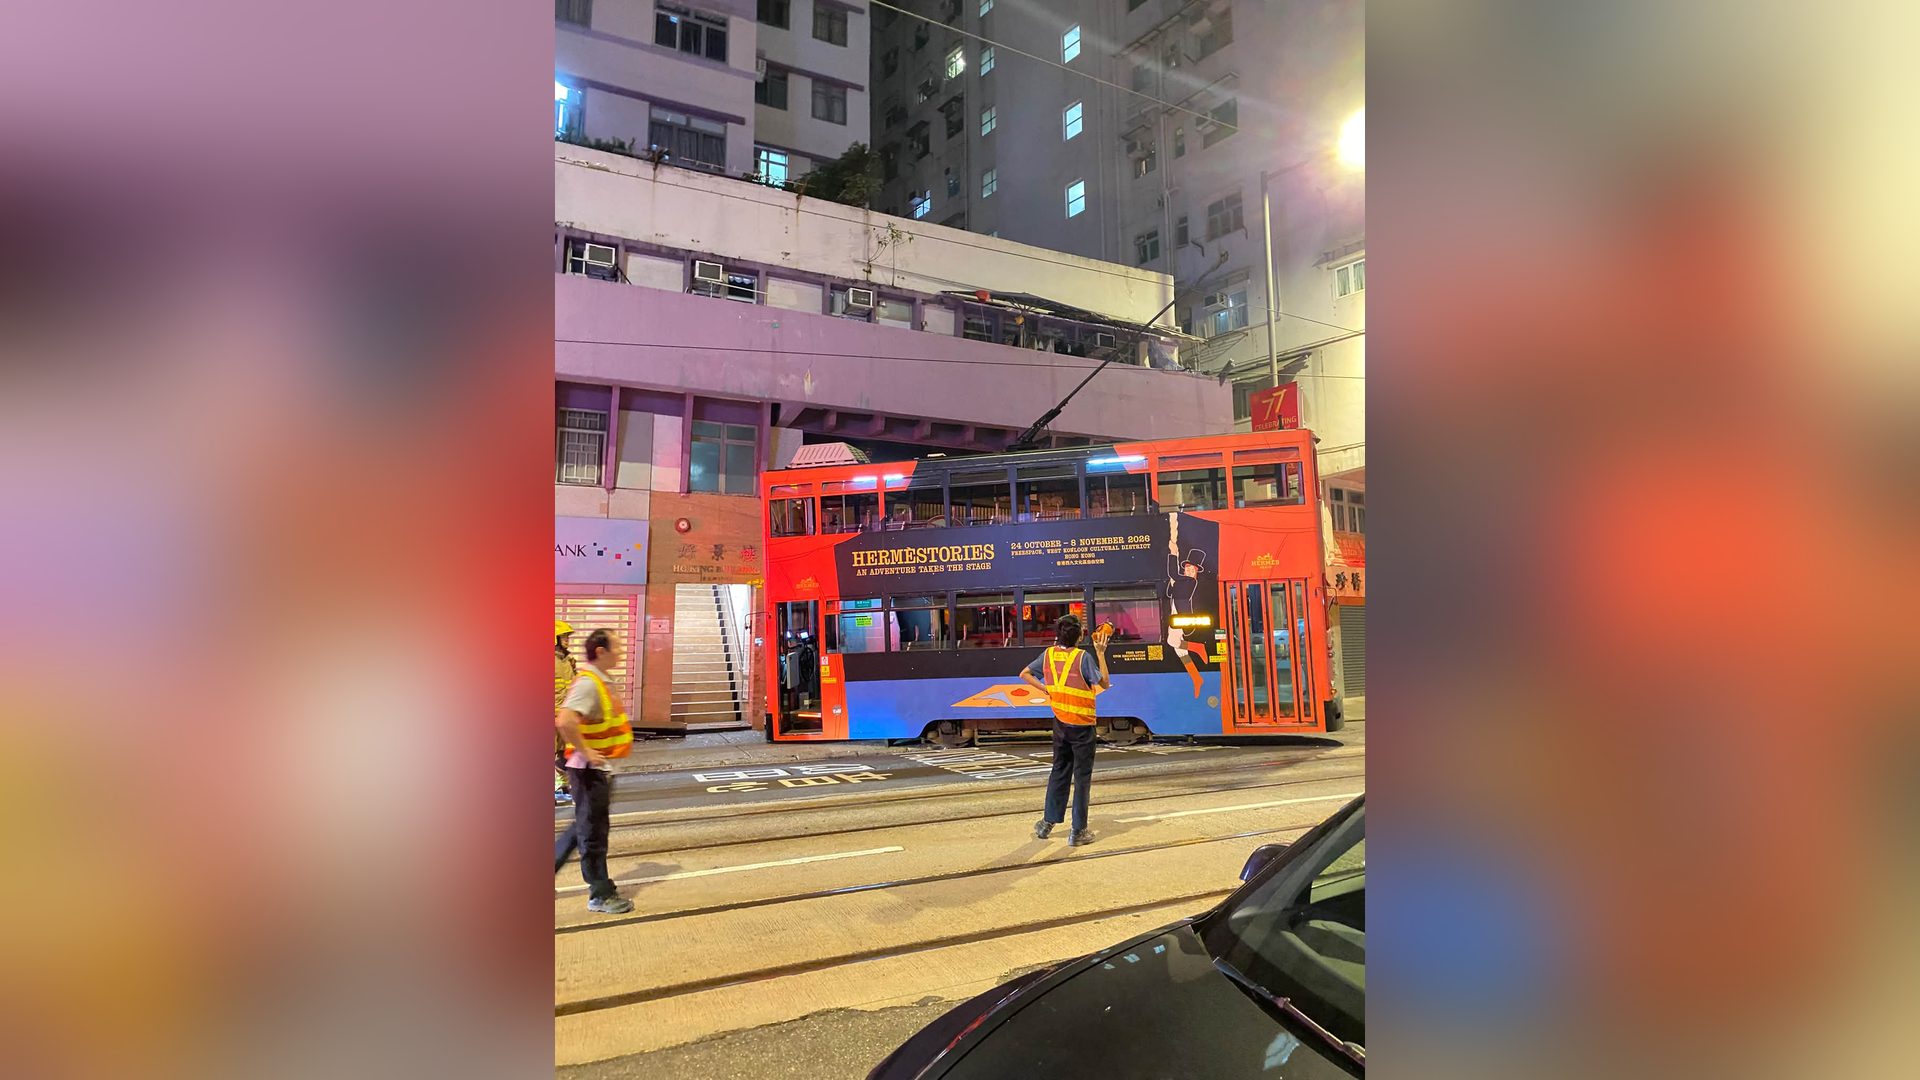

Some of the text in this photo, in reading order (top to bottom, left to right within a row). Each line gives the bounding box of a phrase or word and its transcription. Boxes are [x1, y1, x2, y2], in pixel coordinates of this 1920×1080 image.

[1261, 389, 1287, 421] 77
[1024, 540, 1062, 549] OCTOBER
[1079, 536, 1125, 546] NOVEMBER
[1127, 534, 1151, 543] 2026
[852, 543, 995, 567] HERMÈSTORIES
[689, 565, 714, 573] KING
[856, 562, 991, 576] AN ADVENTURE TAKES THE STAGE
